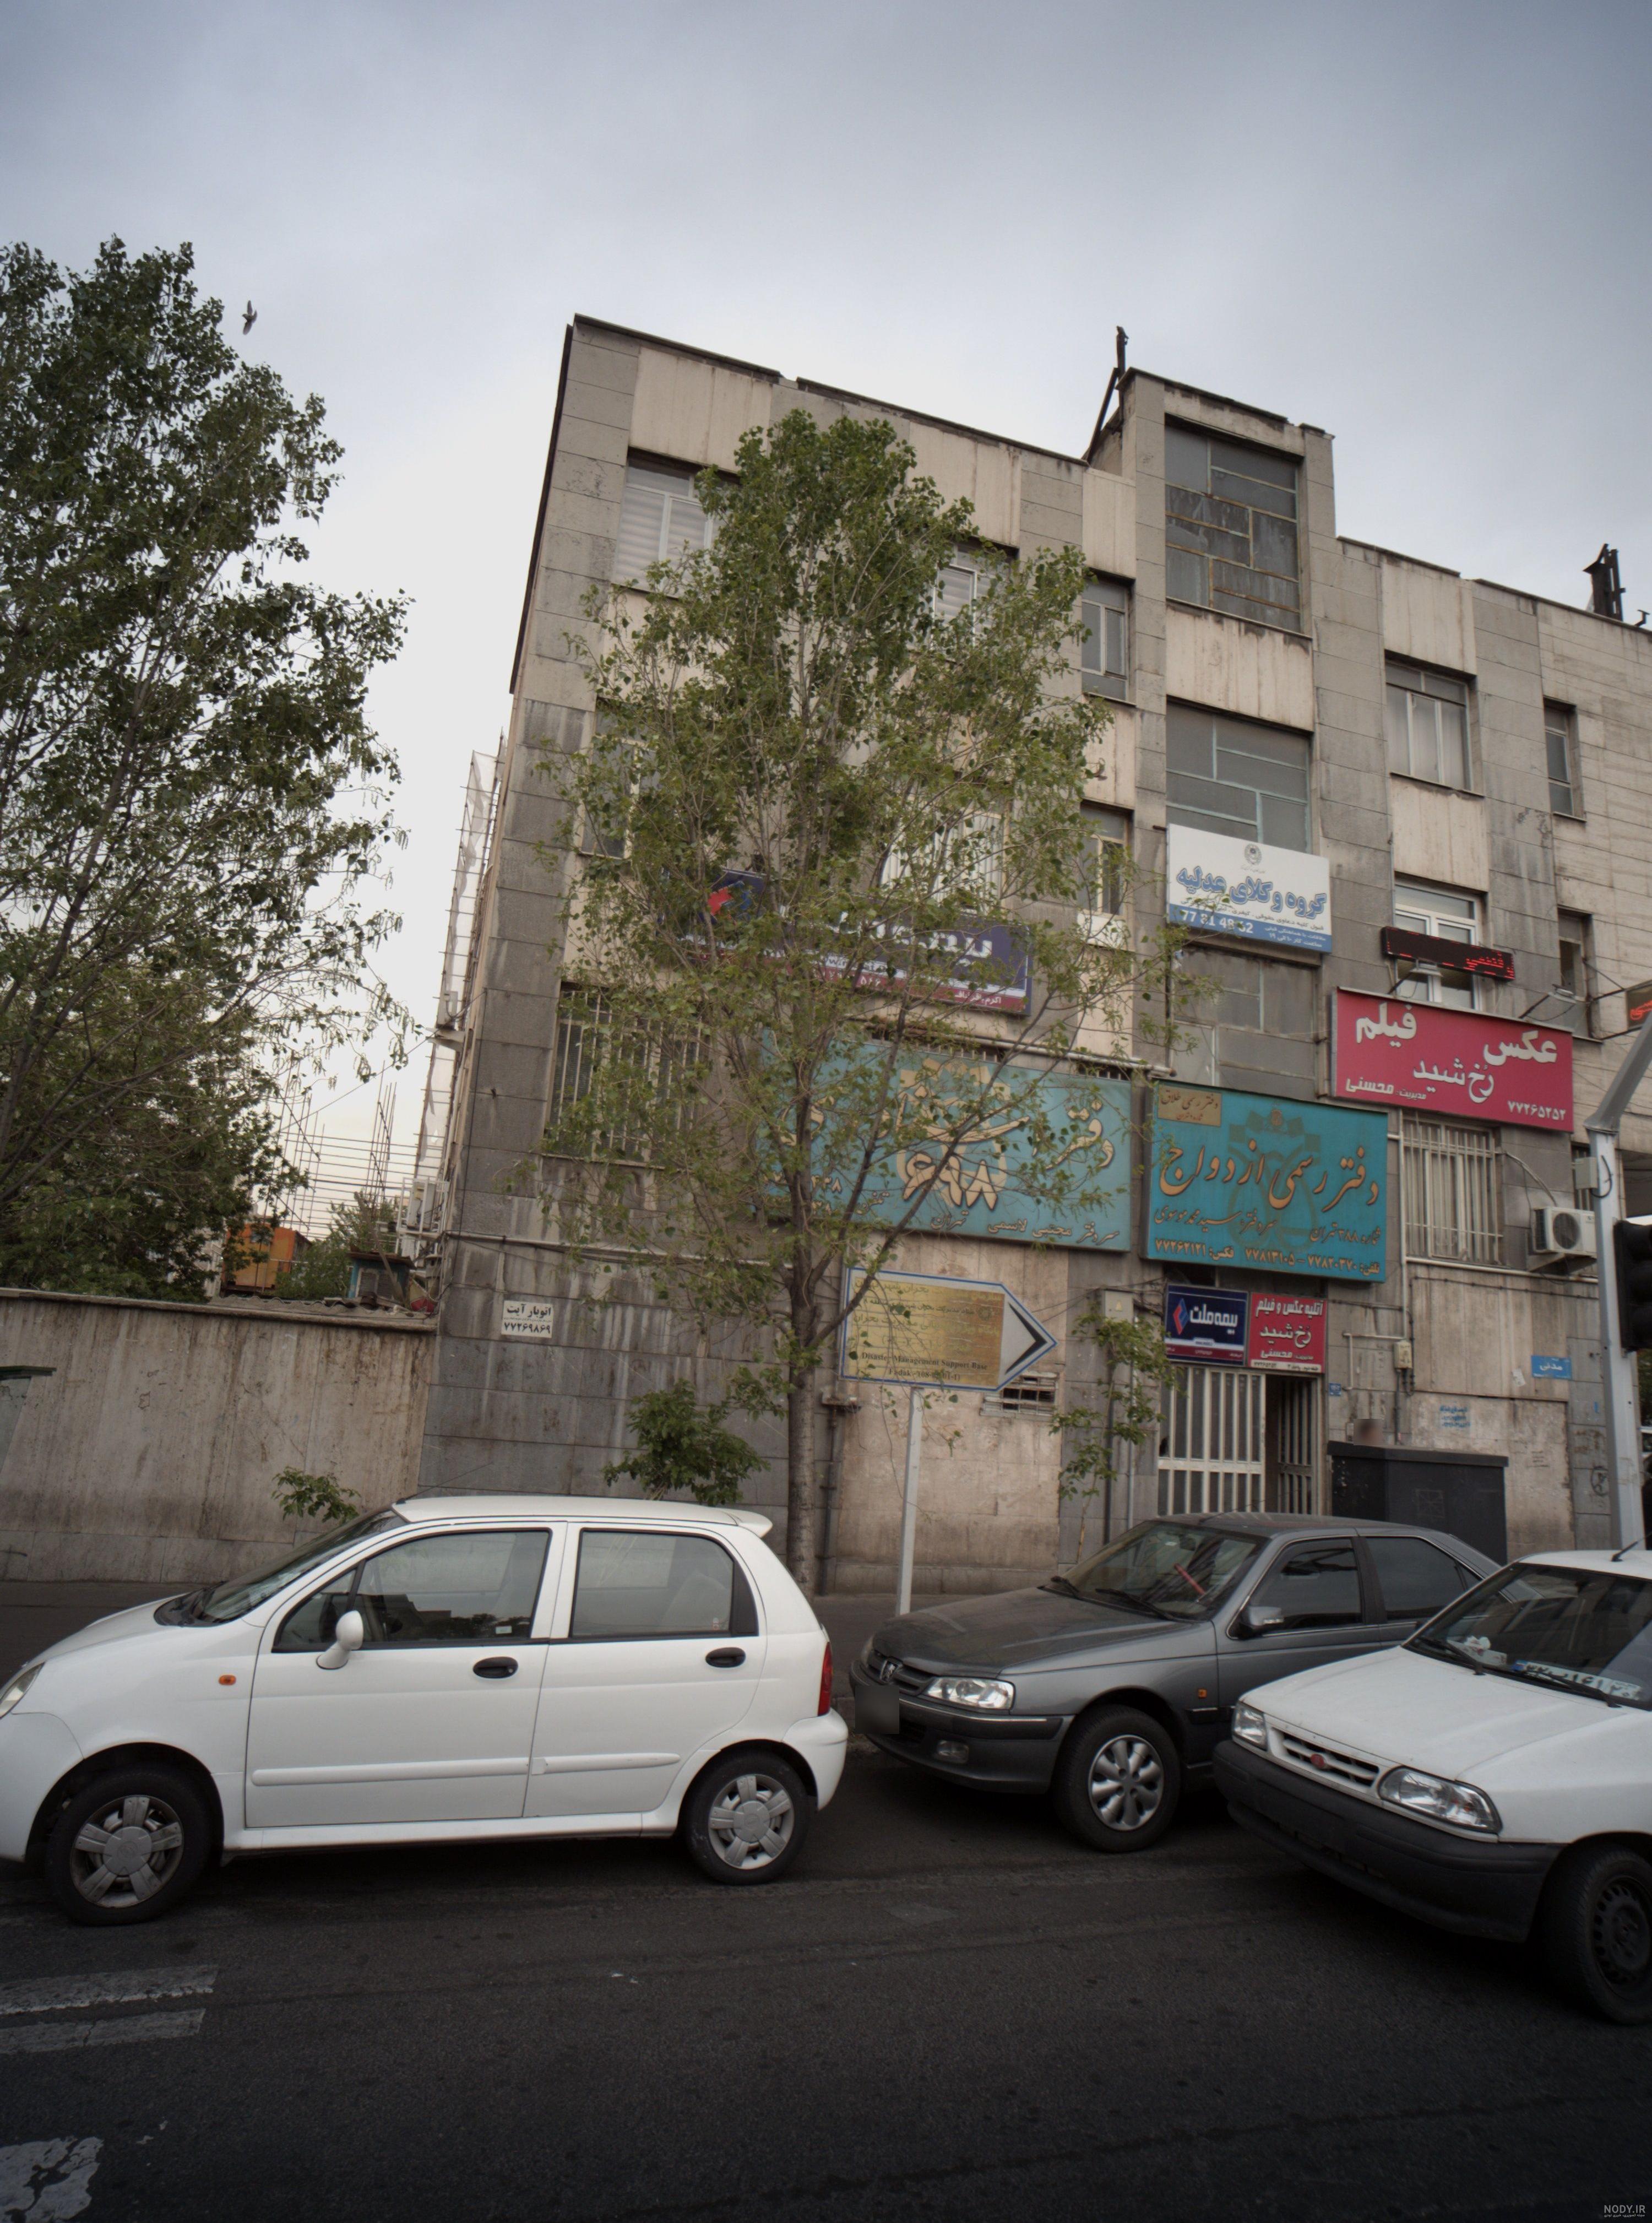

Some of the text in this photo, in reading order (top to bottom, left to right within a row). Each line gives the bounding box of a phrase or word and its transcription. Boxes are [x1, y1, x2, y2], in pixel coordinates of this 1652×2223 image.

[1176, 866, 1226, 894] عدلیه
[1180, 909, 1197, 923] 77
[1286, 892, 1327, 919] گروه
[1355, 1002, 1558, 1066] عکس فیلم
[1345, 1077, 1394, 1094] محسنی
[1160, 1138, 1379, 1212] دفتر رسمی ازدواج
[507, 1303, 551, 1319] اتوبار آیت
[1189, 1303, 1238, 1335] بیمه ملت
[1256, 1298, 1324, 1319] آتلیه عکس و فیلم
[894, 1356, 939, 1366] Management
[942, 1359, 969, 1369] Support
[972, 1362, 988, 1370] Base
[1260, 1348, 1293, 1359] محسنی
